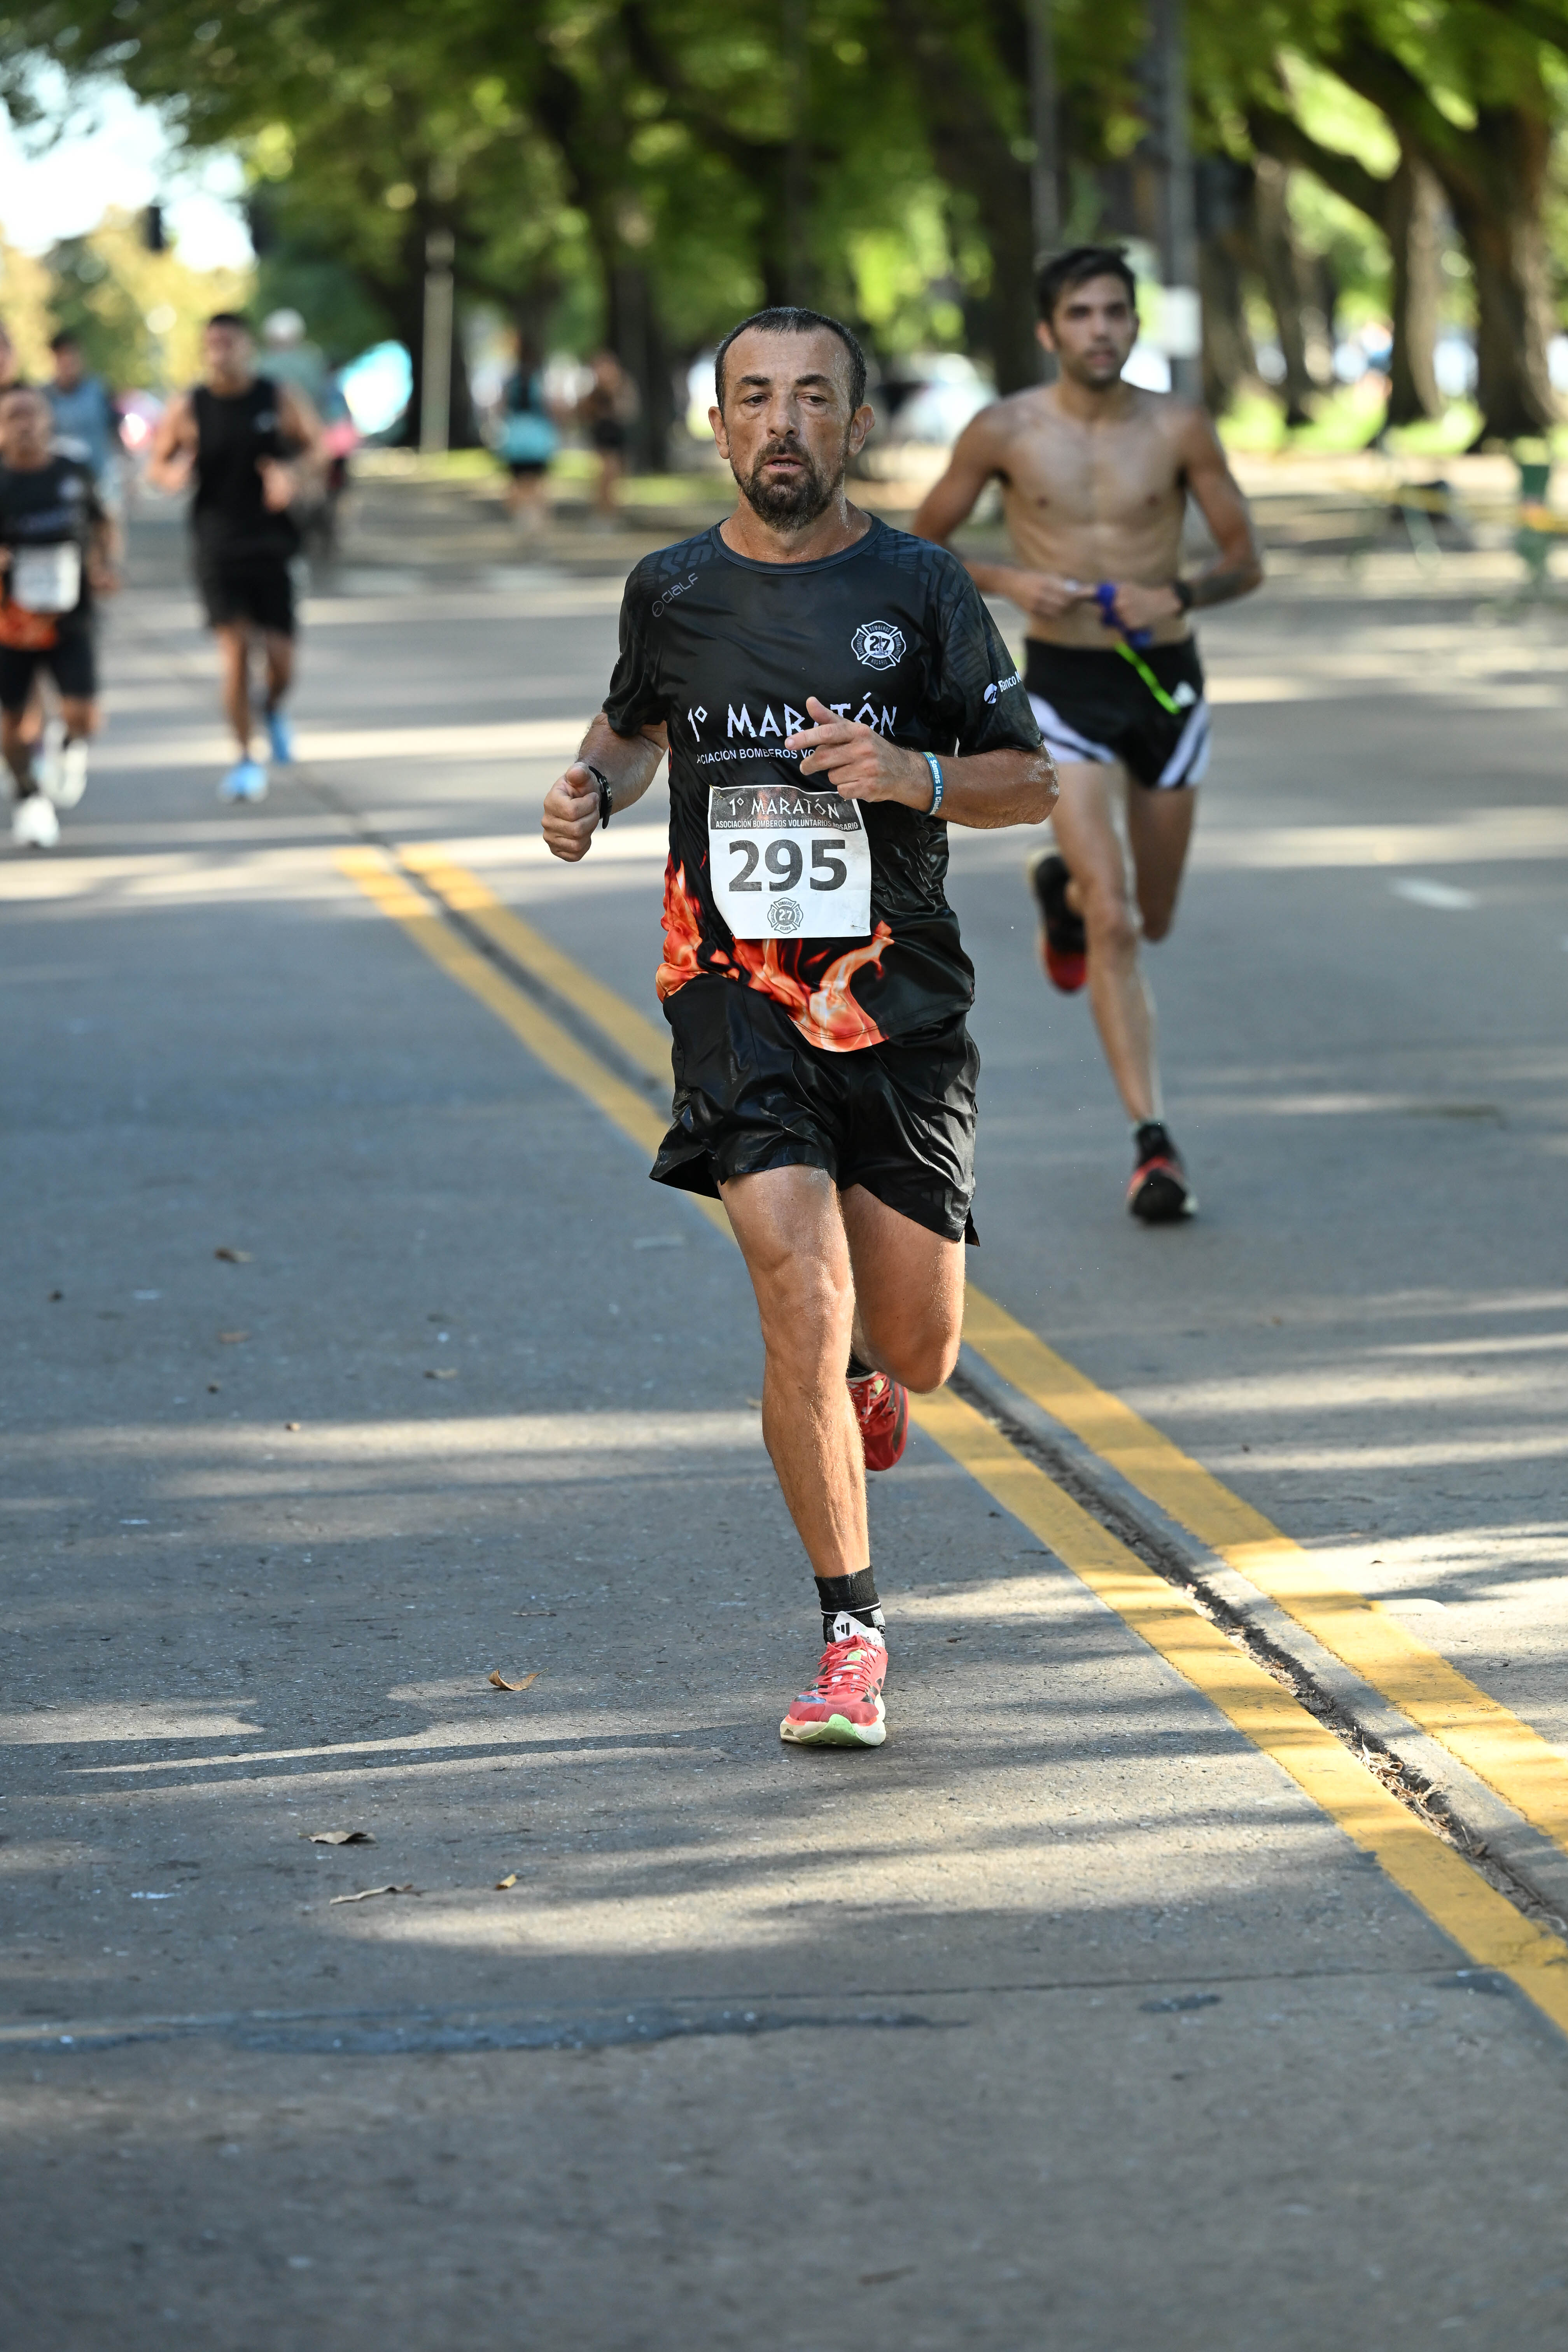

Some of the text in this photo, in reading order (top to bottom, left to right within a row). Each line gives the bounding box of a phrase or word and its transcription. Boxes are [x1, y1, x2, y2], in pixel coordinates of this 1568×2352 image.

[870, 635, 891, 651] 27
[998, 676, 1017, 693] Banco
[727, 691, 897, 738] MARTÓN
[739, 748, 798, 759] BOMBEROS
[930, 759, 941, 784] Somos
[936, 786, 943, 794] La
[751, 797, 840, 819] MARATÓN
[716, 819, 751, 828] ASOCIACIÓN
[788, 819, 831, 827] VOLUNTARIOS
[832, 822, 858, 831] ROSARIO
[729, 839, 847, 892] 295
[779, 908, 793, 921] 27
